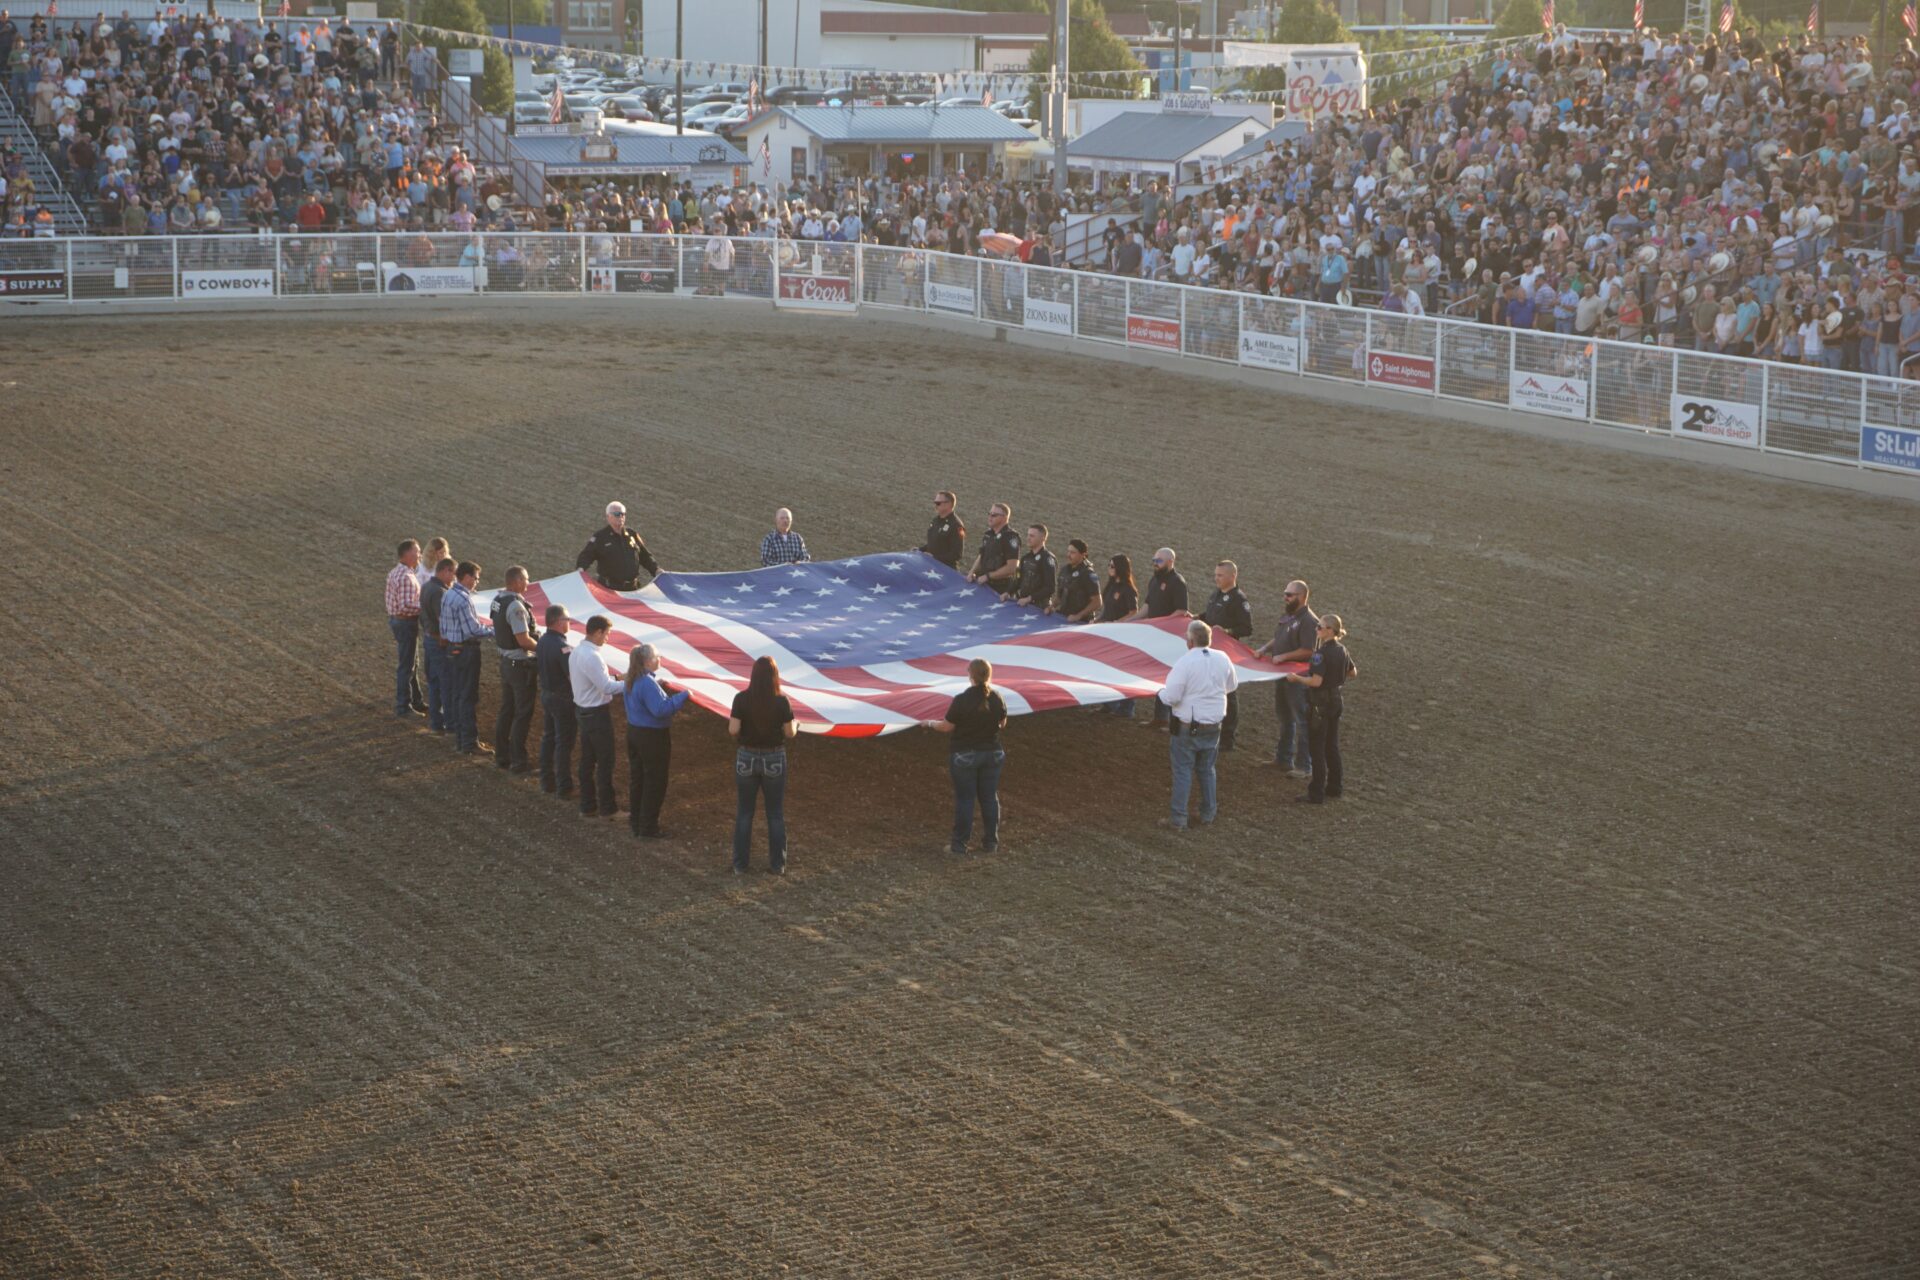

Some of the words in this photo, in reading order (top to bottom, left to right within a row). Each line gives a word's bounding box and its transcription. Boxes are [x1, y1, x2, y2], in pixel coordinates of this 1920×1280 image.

[1289, 75, 1360, 114] Coor
[10, 279, 62, 290] SUPPLY
[198, 278, 271, 290] COWBOY+
[801, 278, 847, 303] Coors
[1026, 308, 1048, 322] ZIONS
[1049, 311, 1069, 326] BANK
[1384, 363, 1400, 375] Saint
[1401, 366, 1431, 379] Alphonsus
[1550, 394, 1574, 402] VALLEY
[1703, 424, 1725, 436] SIGN
[1726, 428, 1752, 440] SHOP
